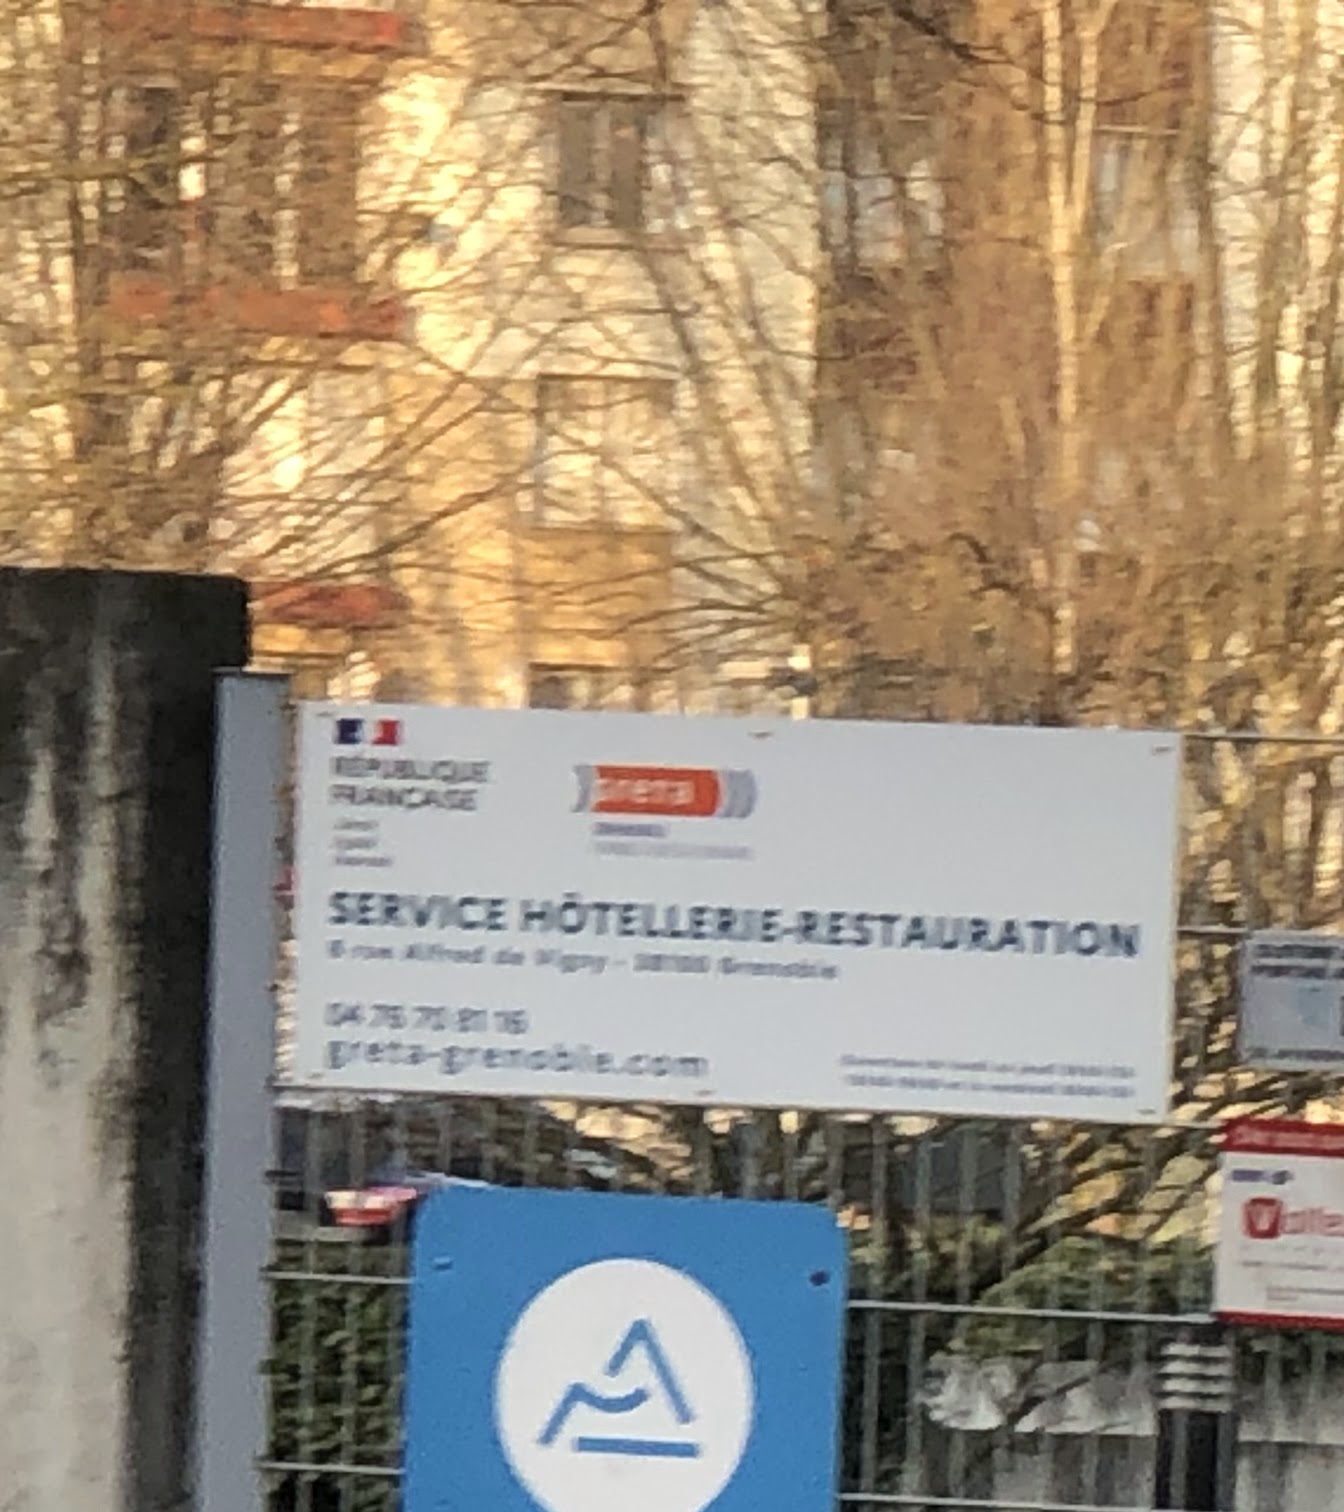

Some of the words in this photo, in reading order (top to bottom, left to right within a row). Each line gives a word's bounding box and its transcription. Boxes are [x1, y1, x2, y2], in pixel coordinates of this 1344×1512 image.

[330, 753, 491, 783] RÉPUBLIQUE
[328, 783, 478, 813] FRANÇAISE
[328, 890, 508, 931] SERVICE
[518, 892, 1142, 958] HÔTELLERIE-RESTAURATION
[326, 1036, 711, 1078] greta-grenoble.com
